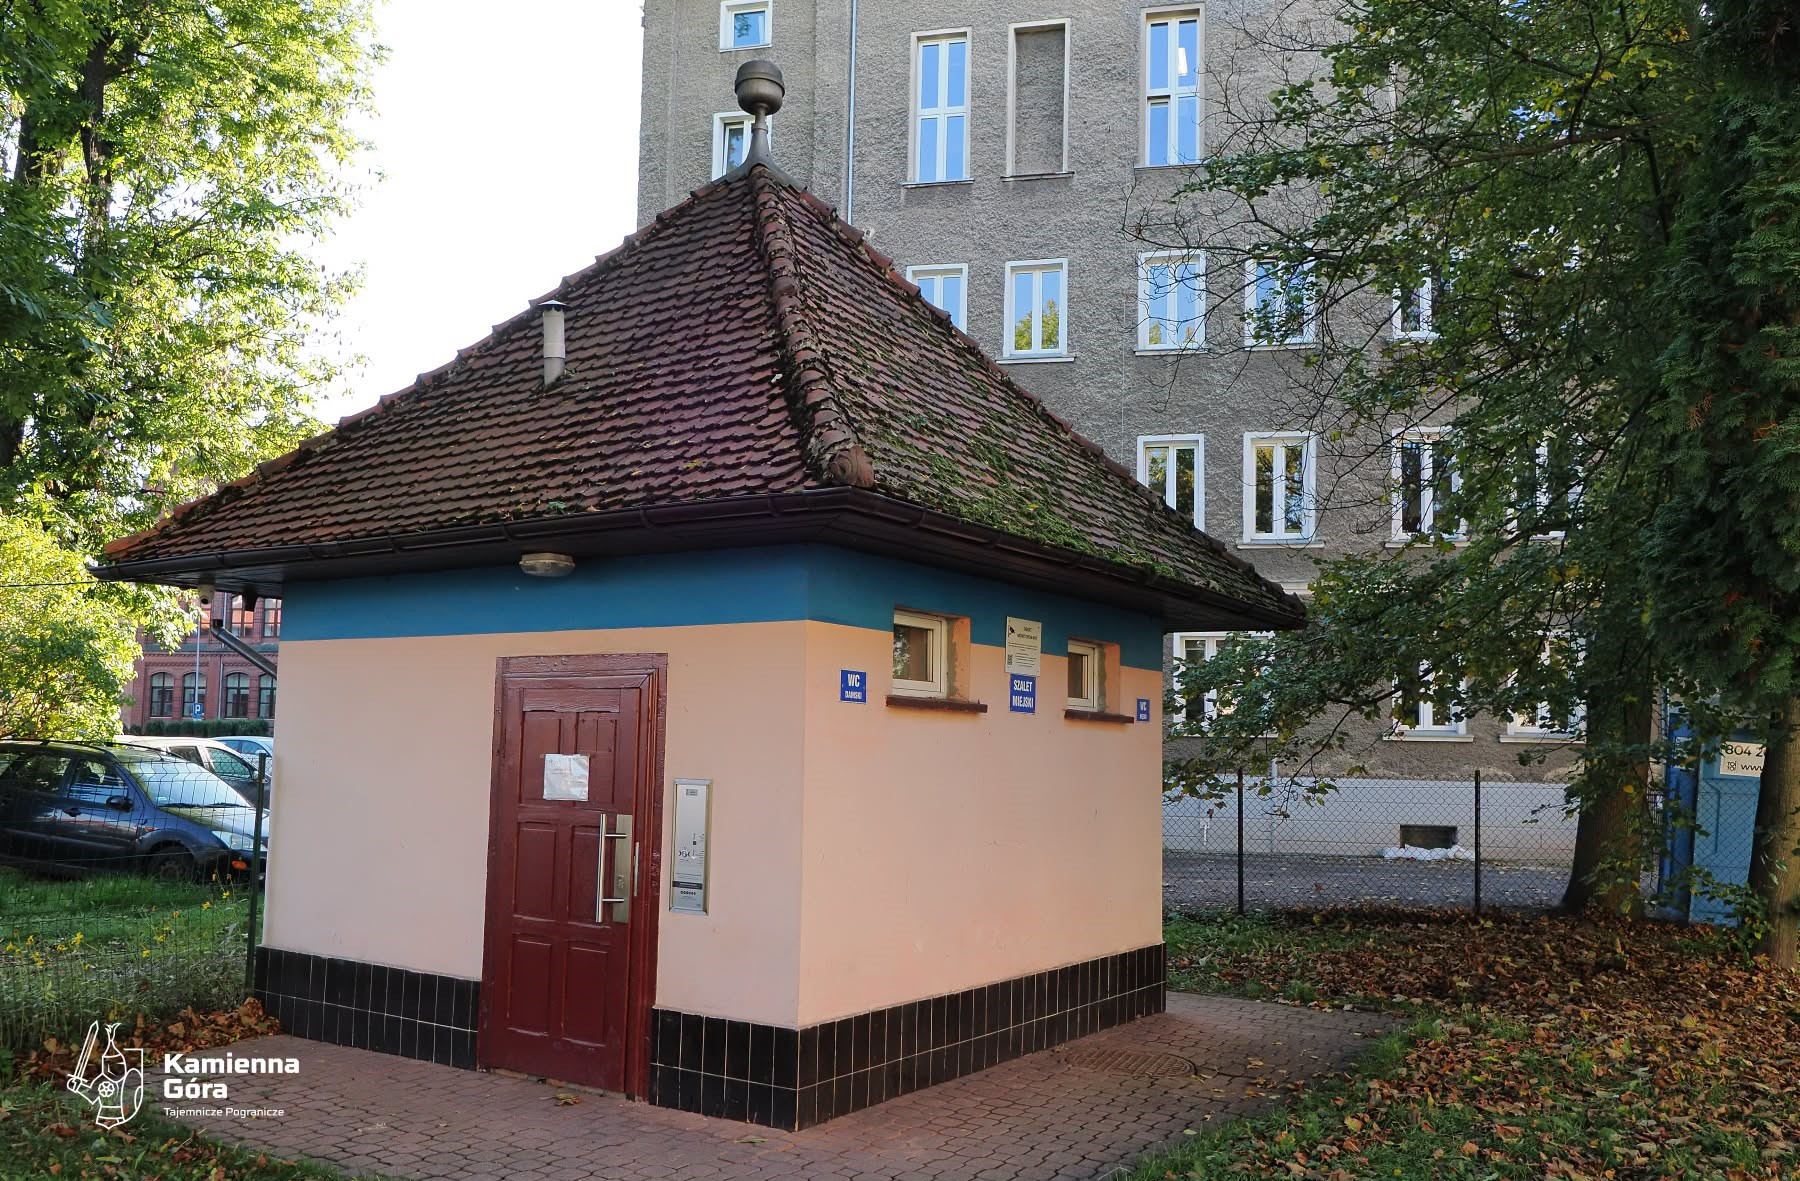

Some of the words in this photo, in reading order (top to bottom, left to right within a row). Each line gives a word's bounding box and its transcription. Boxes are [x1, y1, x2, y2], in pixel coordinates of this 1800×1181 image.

[848, 674, 860, 687] WC
[1013, 679, 1033, 692] SZALET
[1012, 695, 1034, 708] MIEJSKI
[1725, 744, 1752, 756] 804
